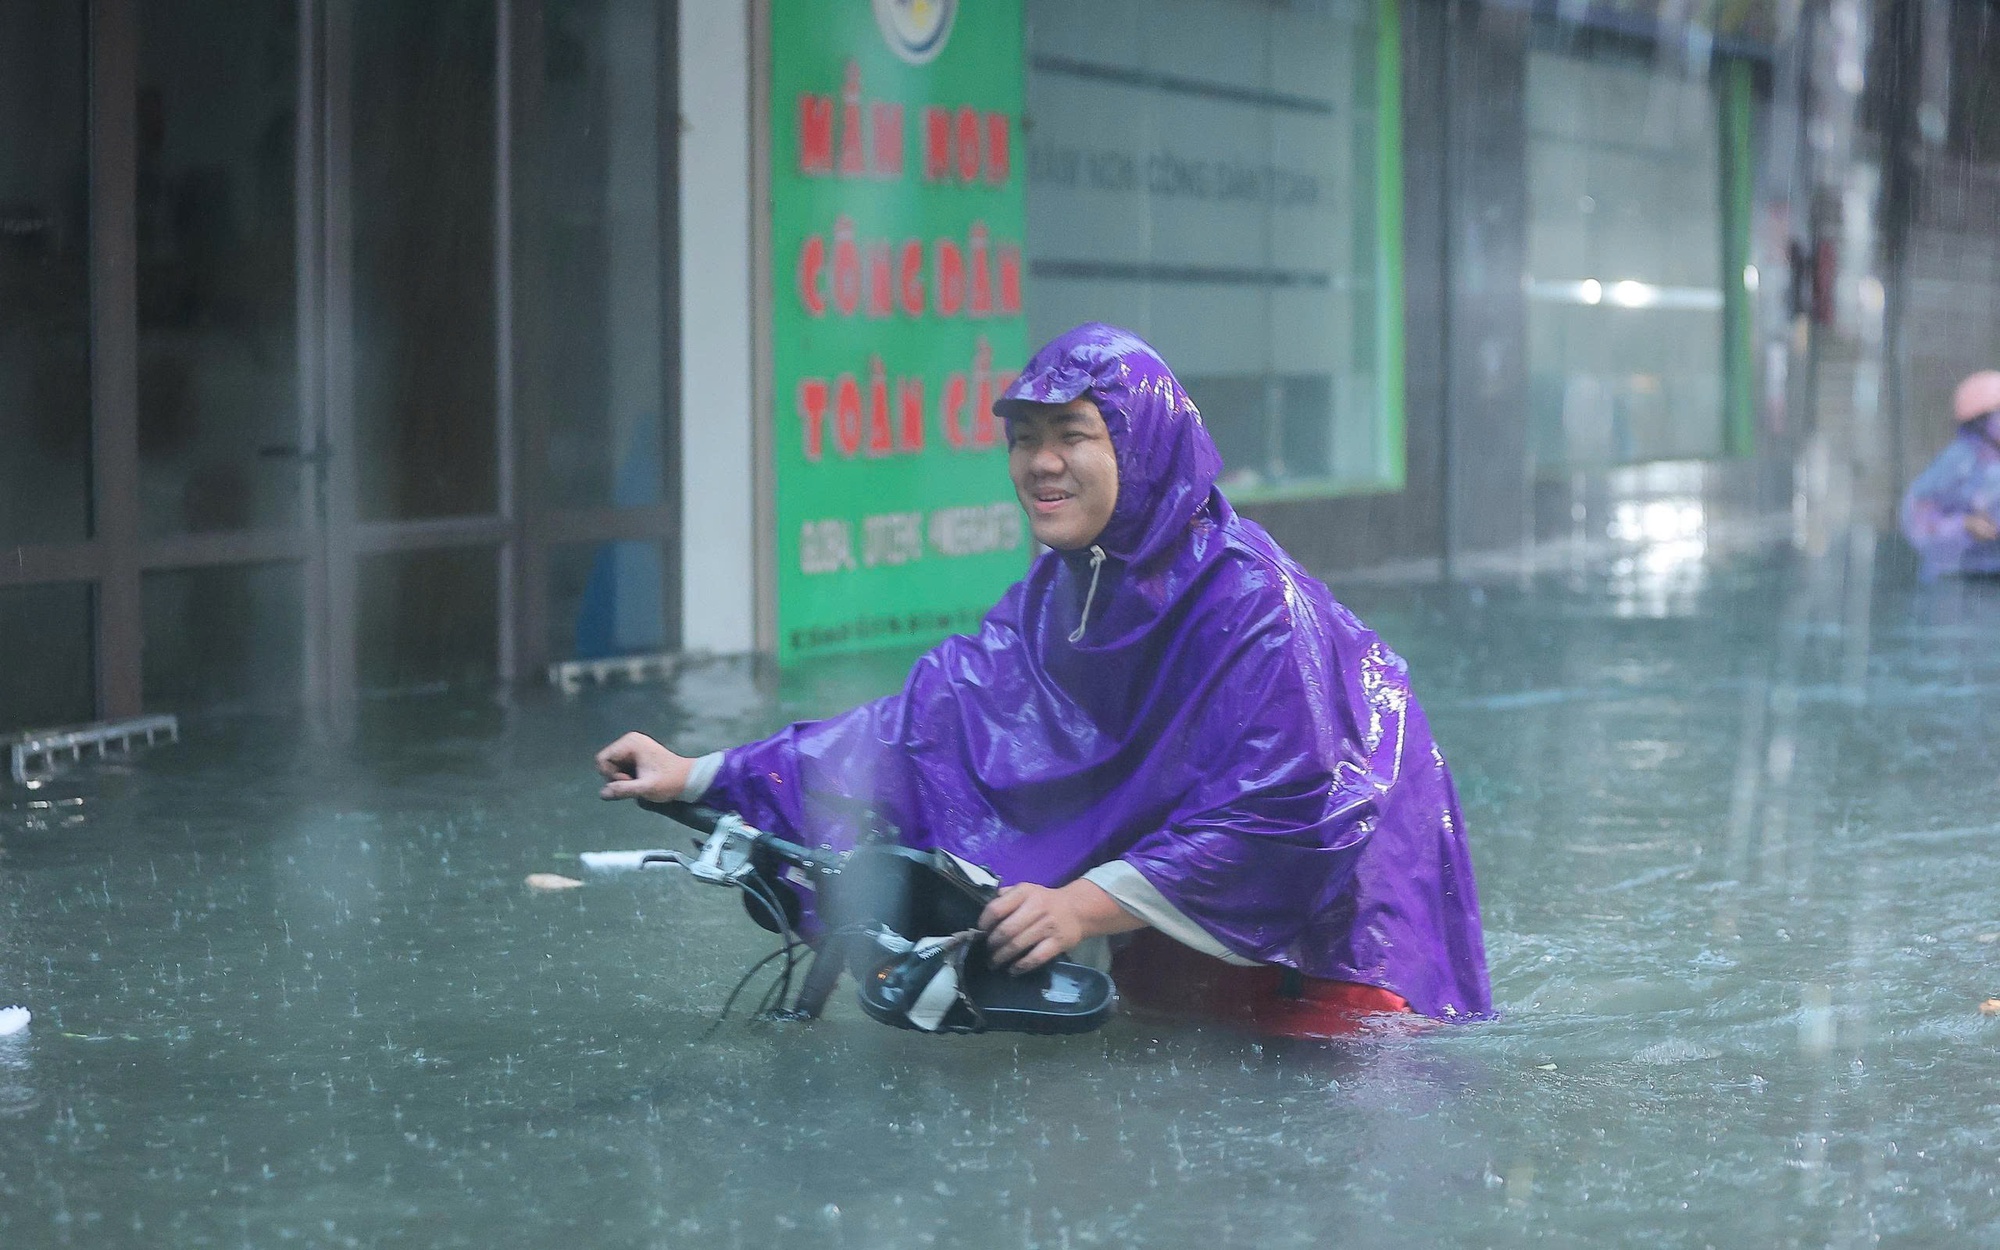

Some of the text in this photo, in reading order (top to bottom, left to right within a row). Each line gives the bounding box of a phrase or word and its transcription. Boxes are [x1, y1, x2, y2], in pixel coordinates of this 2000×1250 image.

[922, 104, 1010, 187] NON
[798, 215, 1022, 319] CÔNG DÂN
[797, 352, 926, 461] TOÀN
